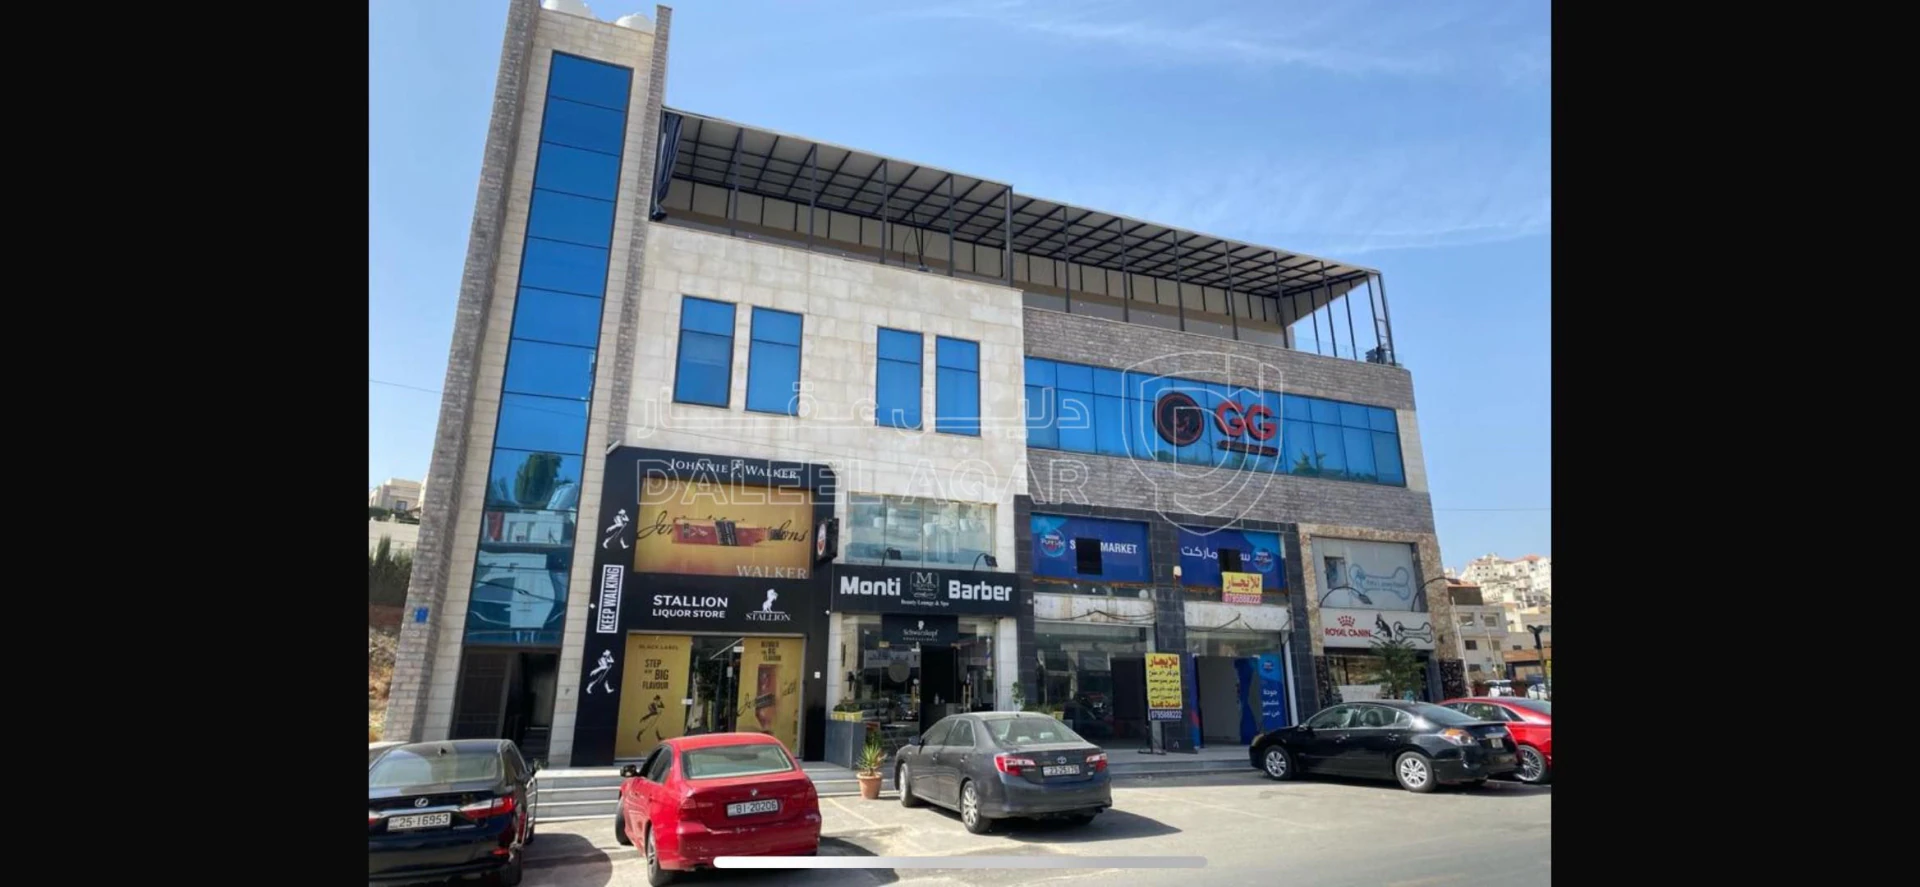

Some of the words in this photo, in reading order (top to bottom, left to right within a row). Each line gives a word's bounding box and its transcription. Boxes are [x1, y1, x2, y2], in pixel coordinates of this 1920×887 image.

[1215, 400, 1278, 441] GG
[1181, 546, 1218, 560] ماركت
[736, 565, 808, 579] WALKER
[604, 567, 620, 604] WALKING
[840, 576, 901, 596] Monti
[948, 580, 1013, 601] Barber
[653, 595, 728, 608] STALLION
[601, 605, 616, 632] KEEP
[652, 609, 691, 618] LIQUOR
[692, 610, 726, 618] STORE
[746, 613, 791, 622] STALLION
[1325, 628, 1347, 637] ROYAL
[1348, 629, 1372, 638] CANIN
[645, 659, 661, 668] STEP
[655, 669, 669, 680] BIG
